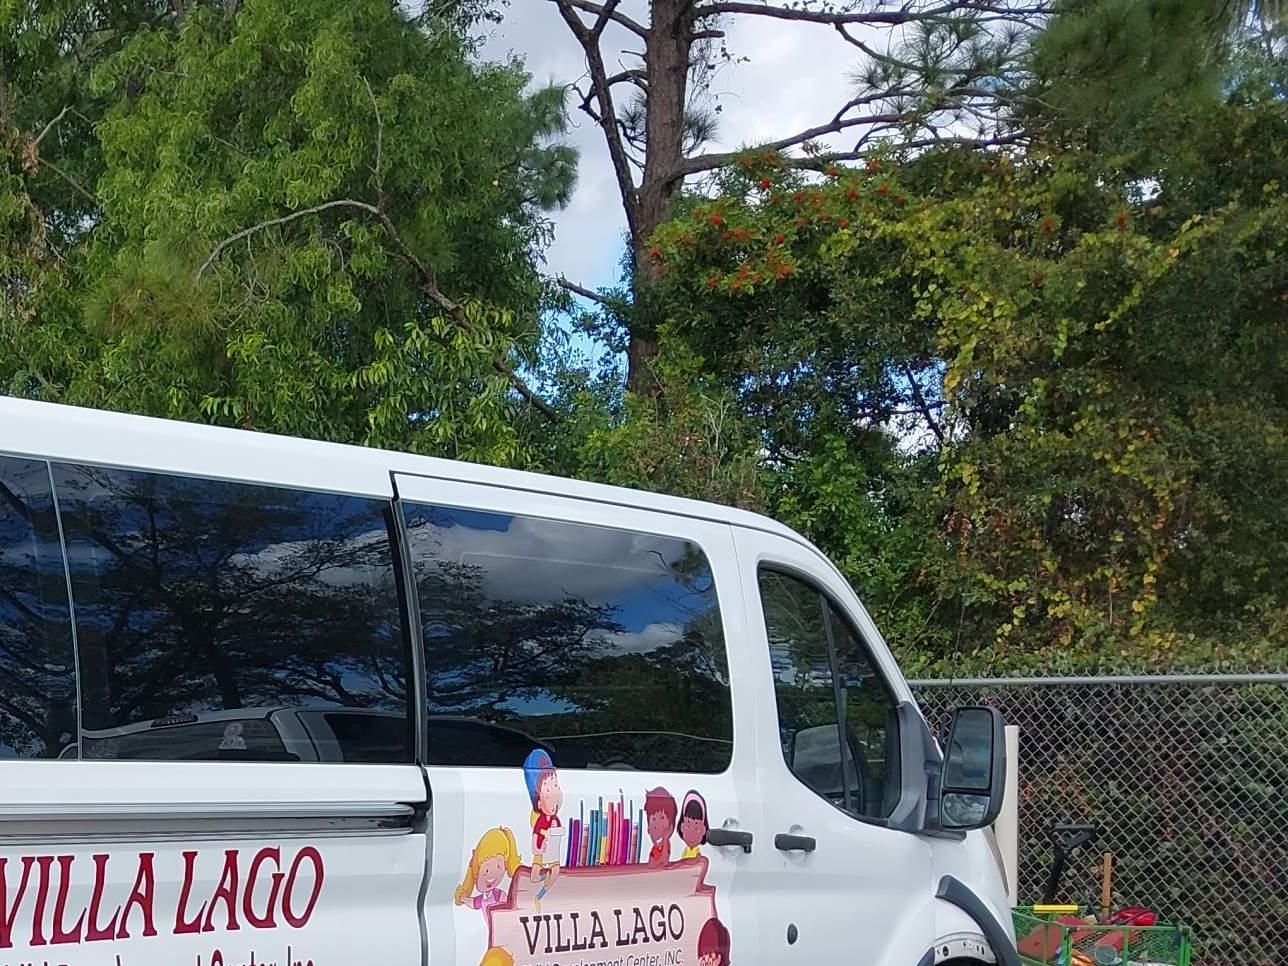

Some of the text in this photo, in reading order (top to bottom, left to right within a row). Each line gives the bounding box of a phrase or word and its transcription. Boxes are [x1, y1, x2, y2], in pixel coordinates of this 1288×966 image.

[173, 846, 324, 934] LAGO
[519, 904, 685, 955] VILLA LAGO
[664, 949, 684, 965] INC.
